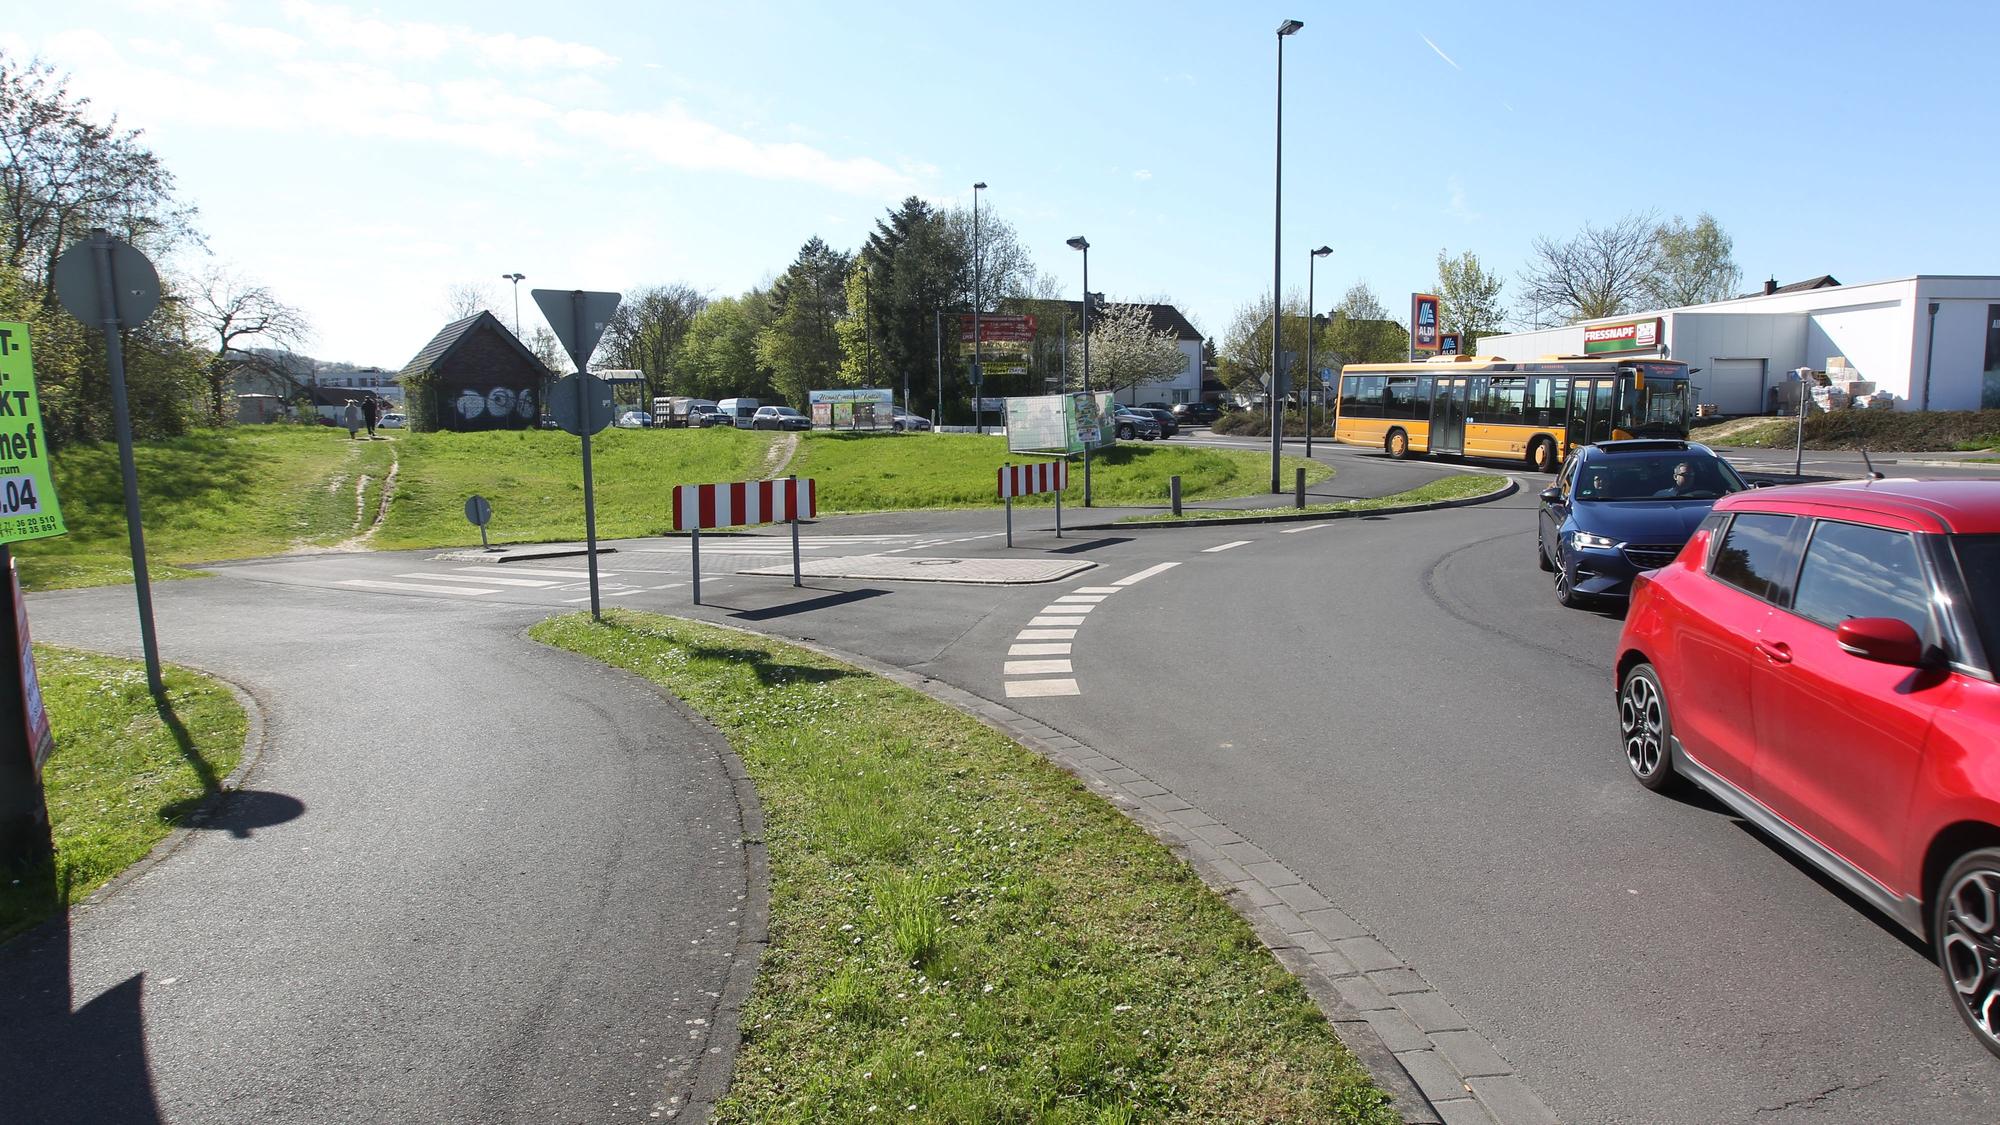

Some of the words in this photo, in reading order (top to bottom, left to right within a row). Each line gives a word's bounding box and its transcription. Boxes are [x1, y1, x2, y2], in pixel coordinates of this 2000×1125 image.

[1418, 326, 1435, 337] ALDI
[1585, 326, 1635, 341] FRESSNAPF
[0, 479, 37, 514] .04
[39, 515, 55, 524] 510
[29, 525, 39, 533] 35
[41, 523, 57, 531] 891
